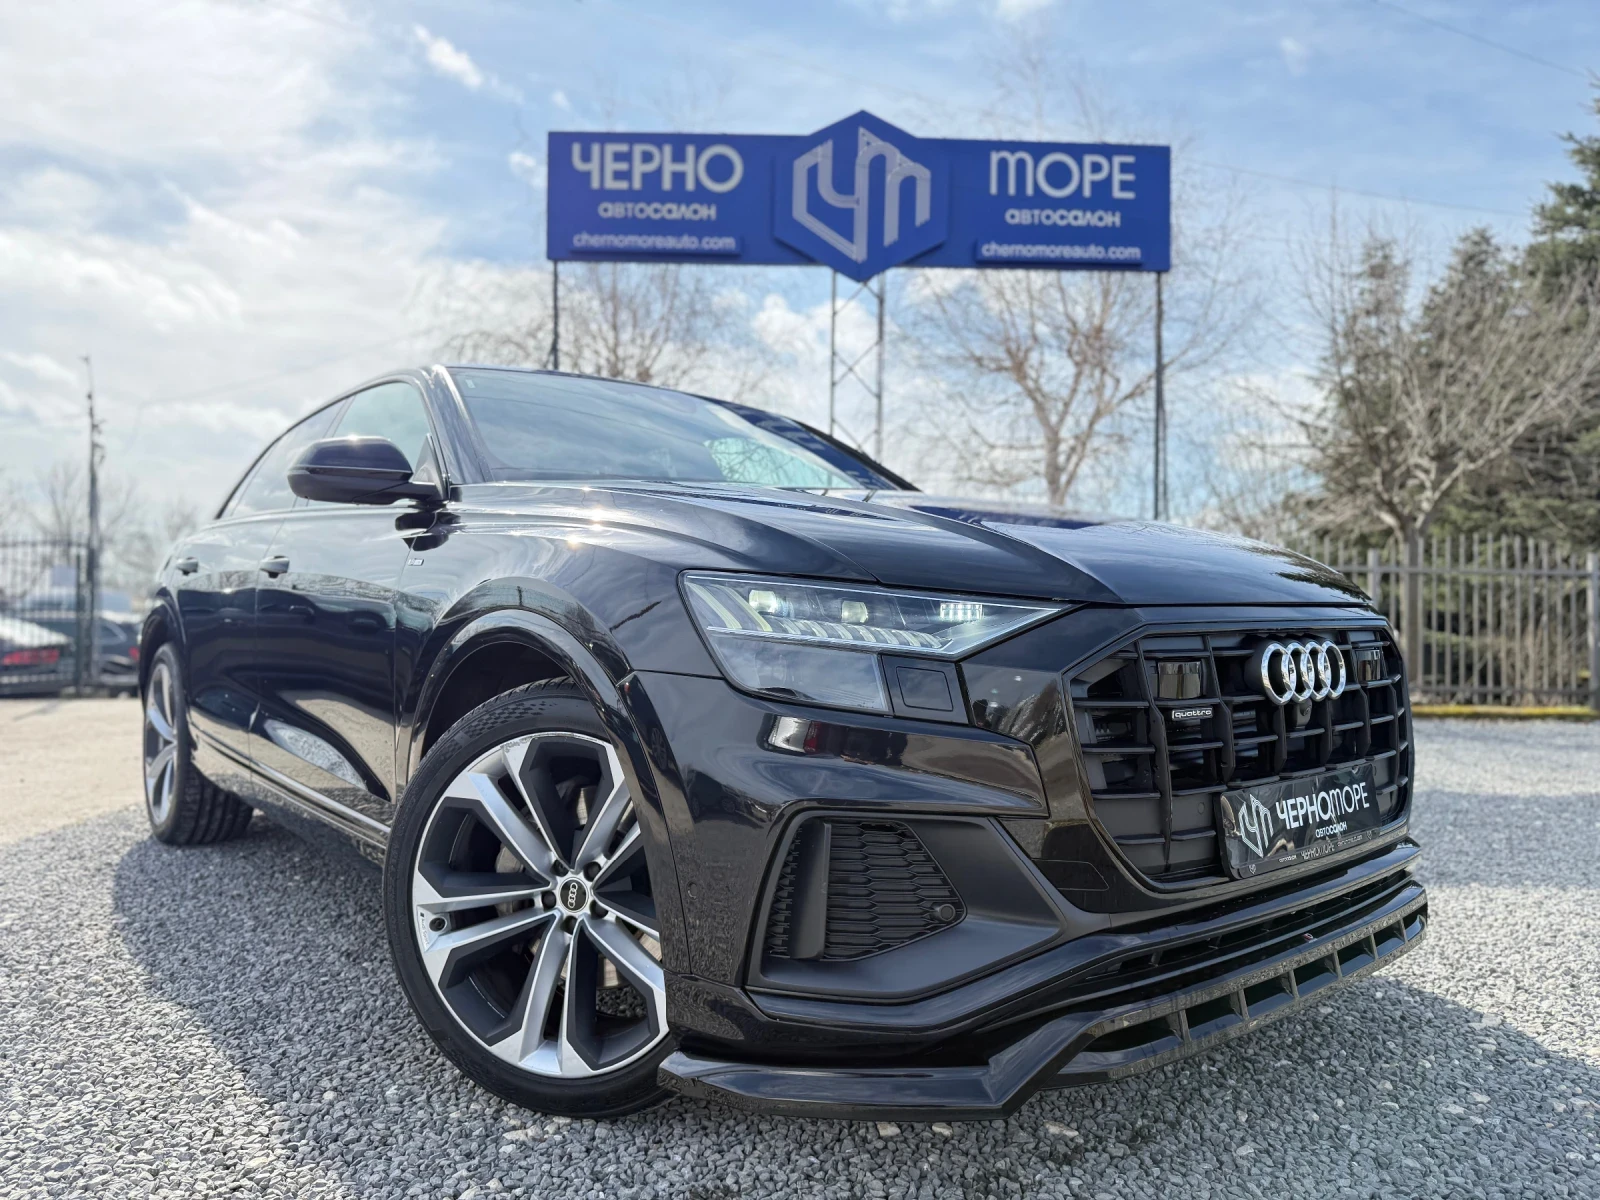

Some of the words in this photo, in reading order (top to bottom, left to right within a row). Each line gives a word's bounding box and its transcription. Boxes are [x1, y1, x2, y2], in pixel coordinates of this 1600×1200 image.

[571, 142, 744, 193] ЧЕРНО
[989, 150, 1136, 199] МОРЕ
[573, 232, 736, 250] chernomoreauto.com
[981, 241, 1142, 260] chernomoreauto.com
[1174, 709, 1212, 718] quattro
